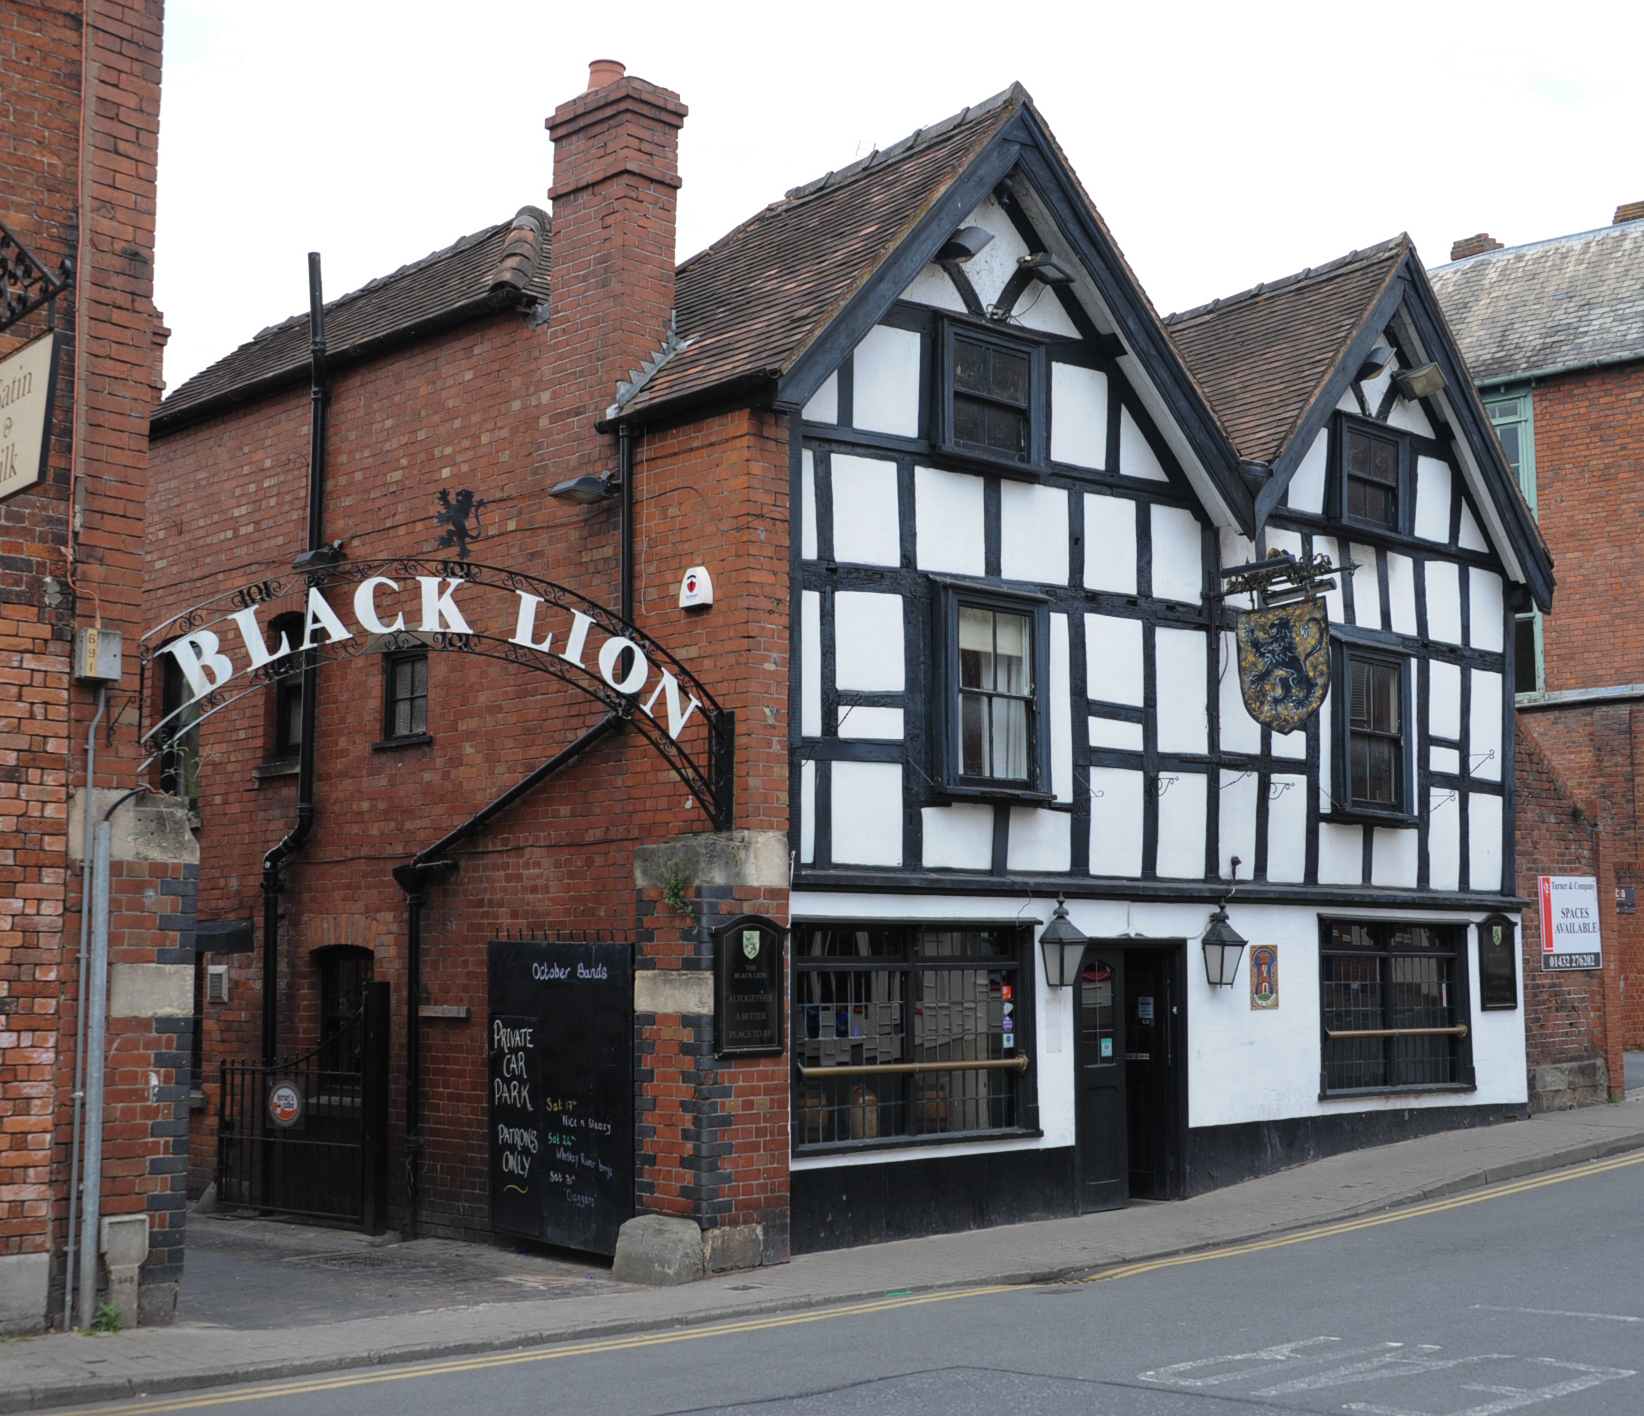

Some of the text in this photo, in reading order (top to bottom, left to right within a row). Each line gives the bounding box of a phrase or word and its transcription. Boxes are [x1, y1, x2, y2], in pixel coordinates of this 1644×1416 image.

[0, 441, 19, 484] ilk
[163, 575, 703, 741] BLACK LION
[1551, 882, 1595, 892] Turner & Company
[1561, 907, 1590, 919] SPACES
[1555, 922, 1598, 934] AVAILABLE
[745, 964, 757, 972] THE
[1549, 954, 1596, 968] 01432 276202
[532, 962, 608, 980] October Bands
[728, 994, 774, 1003] ALTOGETHER
[741, 1012, 767, 1020] BETTER
[493, 1019, 535, 1054] PRIVATE
[729, 1029, 772, 1039] PLACE TO BE
[503, 1051, 528, 1079] CAR
[493, 1078, 534, 1112] PARK
[545, 1097, 563, 1111] Sat
[498, 1123, 539, 1154] PATRONS
[547, 1131, 561, 1145] Sat
[502, 1151, 532, 1179] ONLY
[549, 1170, 563, 1183] Sat
